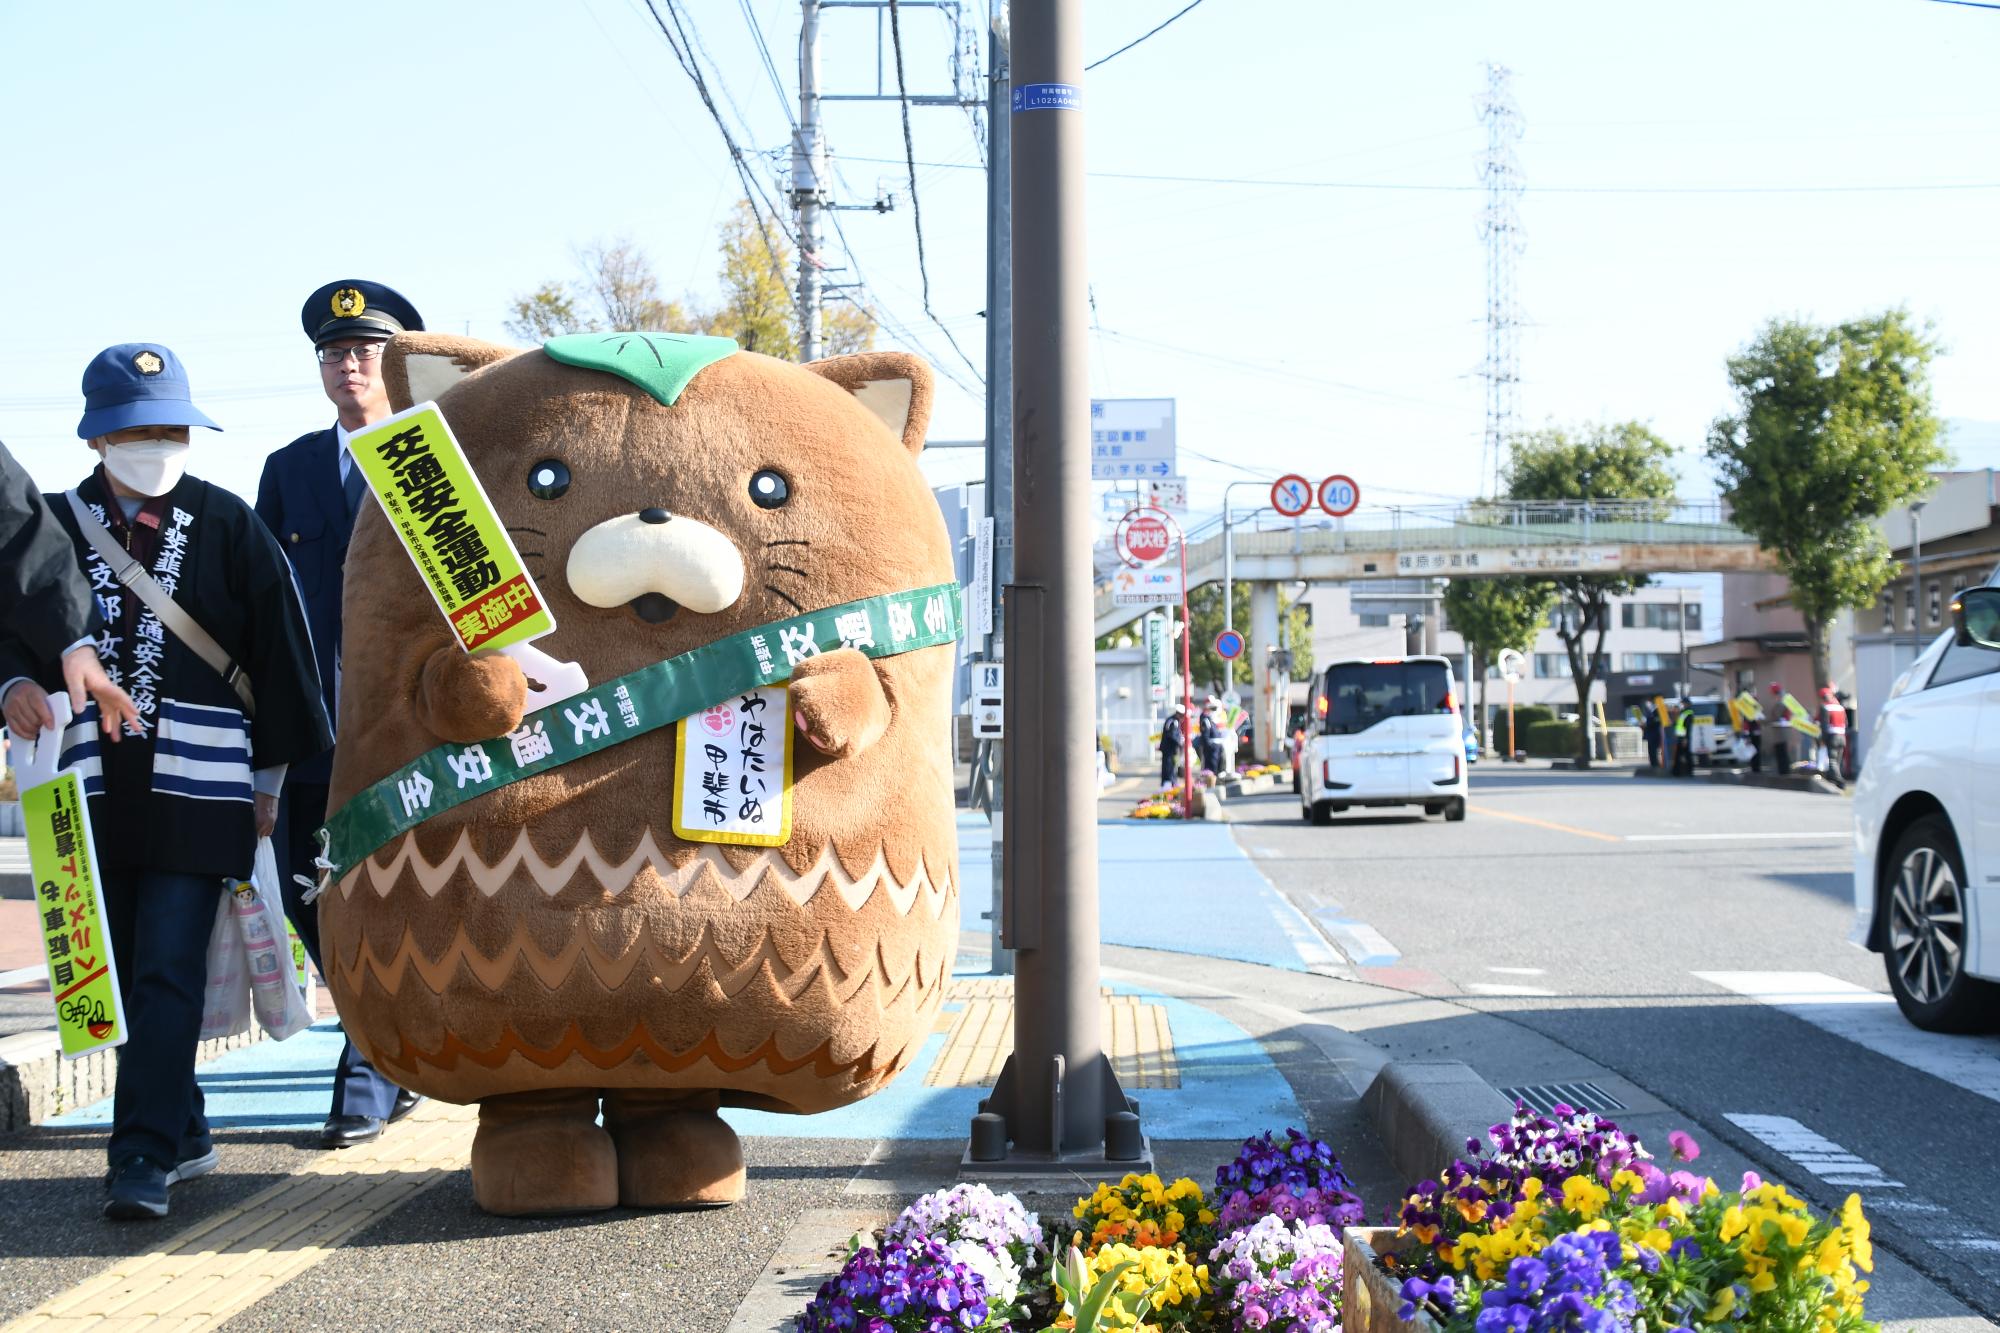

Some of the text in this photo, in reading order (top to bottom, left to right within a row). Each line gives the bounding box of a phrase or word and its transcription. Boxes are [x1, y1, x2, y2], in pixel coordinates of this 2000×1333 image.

[1092, 445, 1122, 457] 民館
[376, 424, 502, 602] 交通安全運動
[1327, 485, 1351, 506] 40
[1128, 529, 1168, 548] 消火栓
[123, 506, 194, 740] 甲斐韮崎通安全協会
[455, 583, 533, 645] 実施中
[778, 594, 947, 667] 交通安全
[750, 634, 775, 676] 甲斐市
[613, 684, 640, 729] 甲斐市
[397, 697, 612, 818] 交通安全
[702, 743, 730, 825] 甲斐市
[738, 692, 767, 824] やはたいぬ
[41, 880, 75, 986] 自転車も
